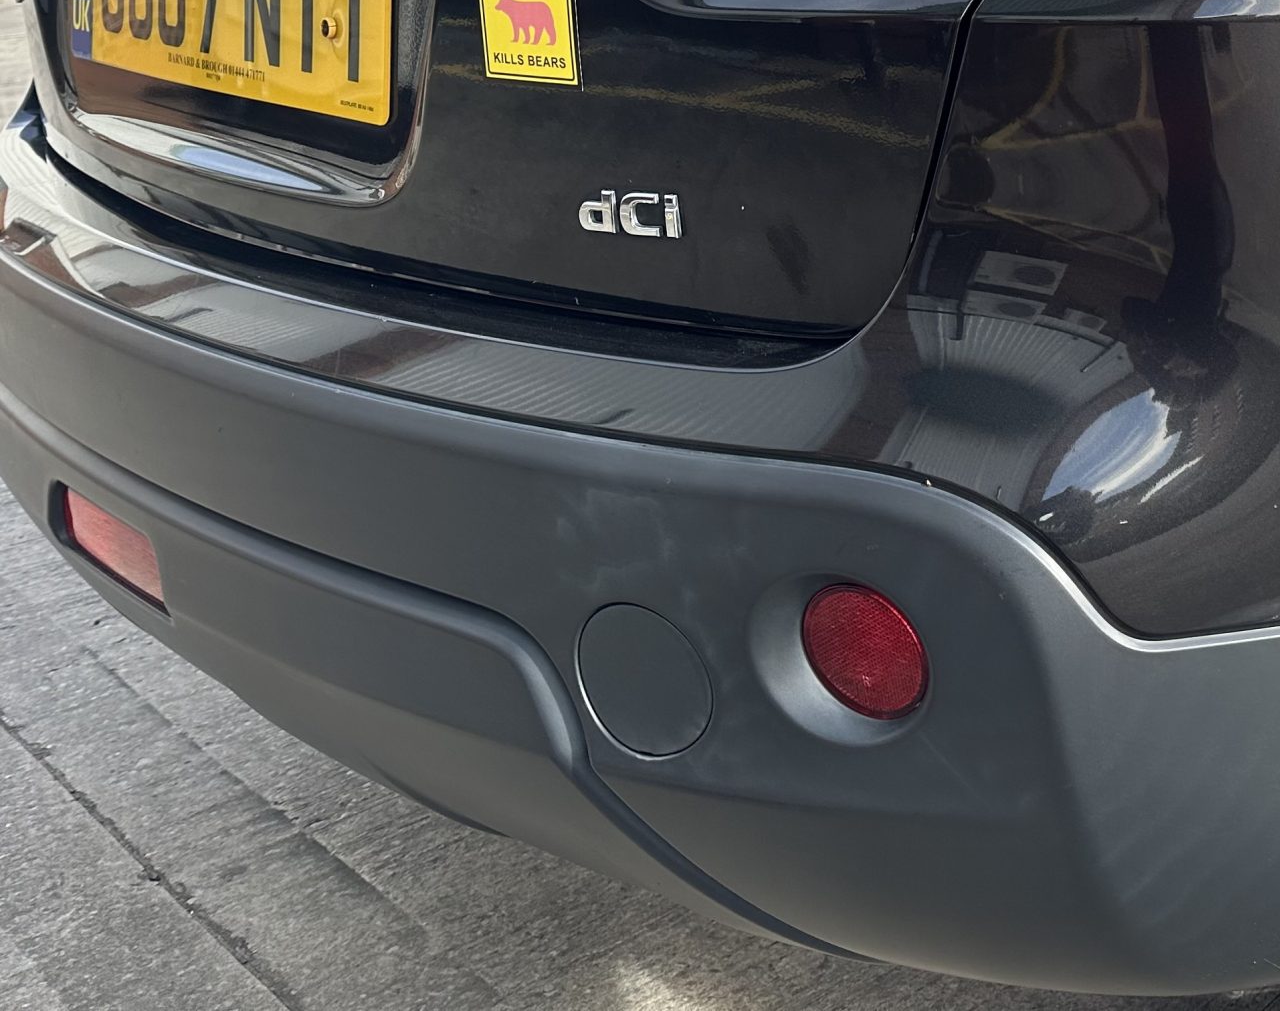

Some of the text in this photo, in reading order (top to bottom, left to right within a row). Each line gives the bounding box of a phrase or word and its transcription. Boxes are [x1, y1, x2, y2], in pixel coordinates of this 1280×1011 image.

[168, 52, 195, 68] BARNARD
[494, 52, 566, 69] KILLS BEARS
[579, 190, 682, 239] dCi
